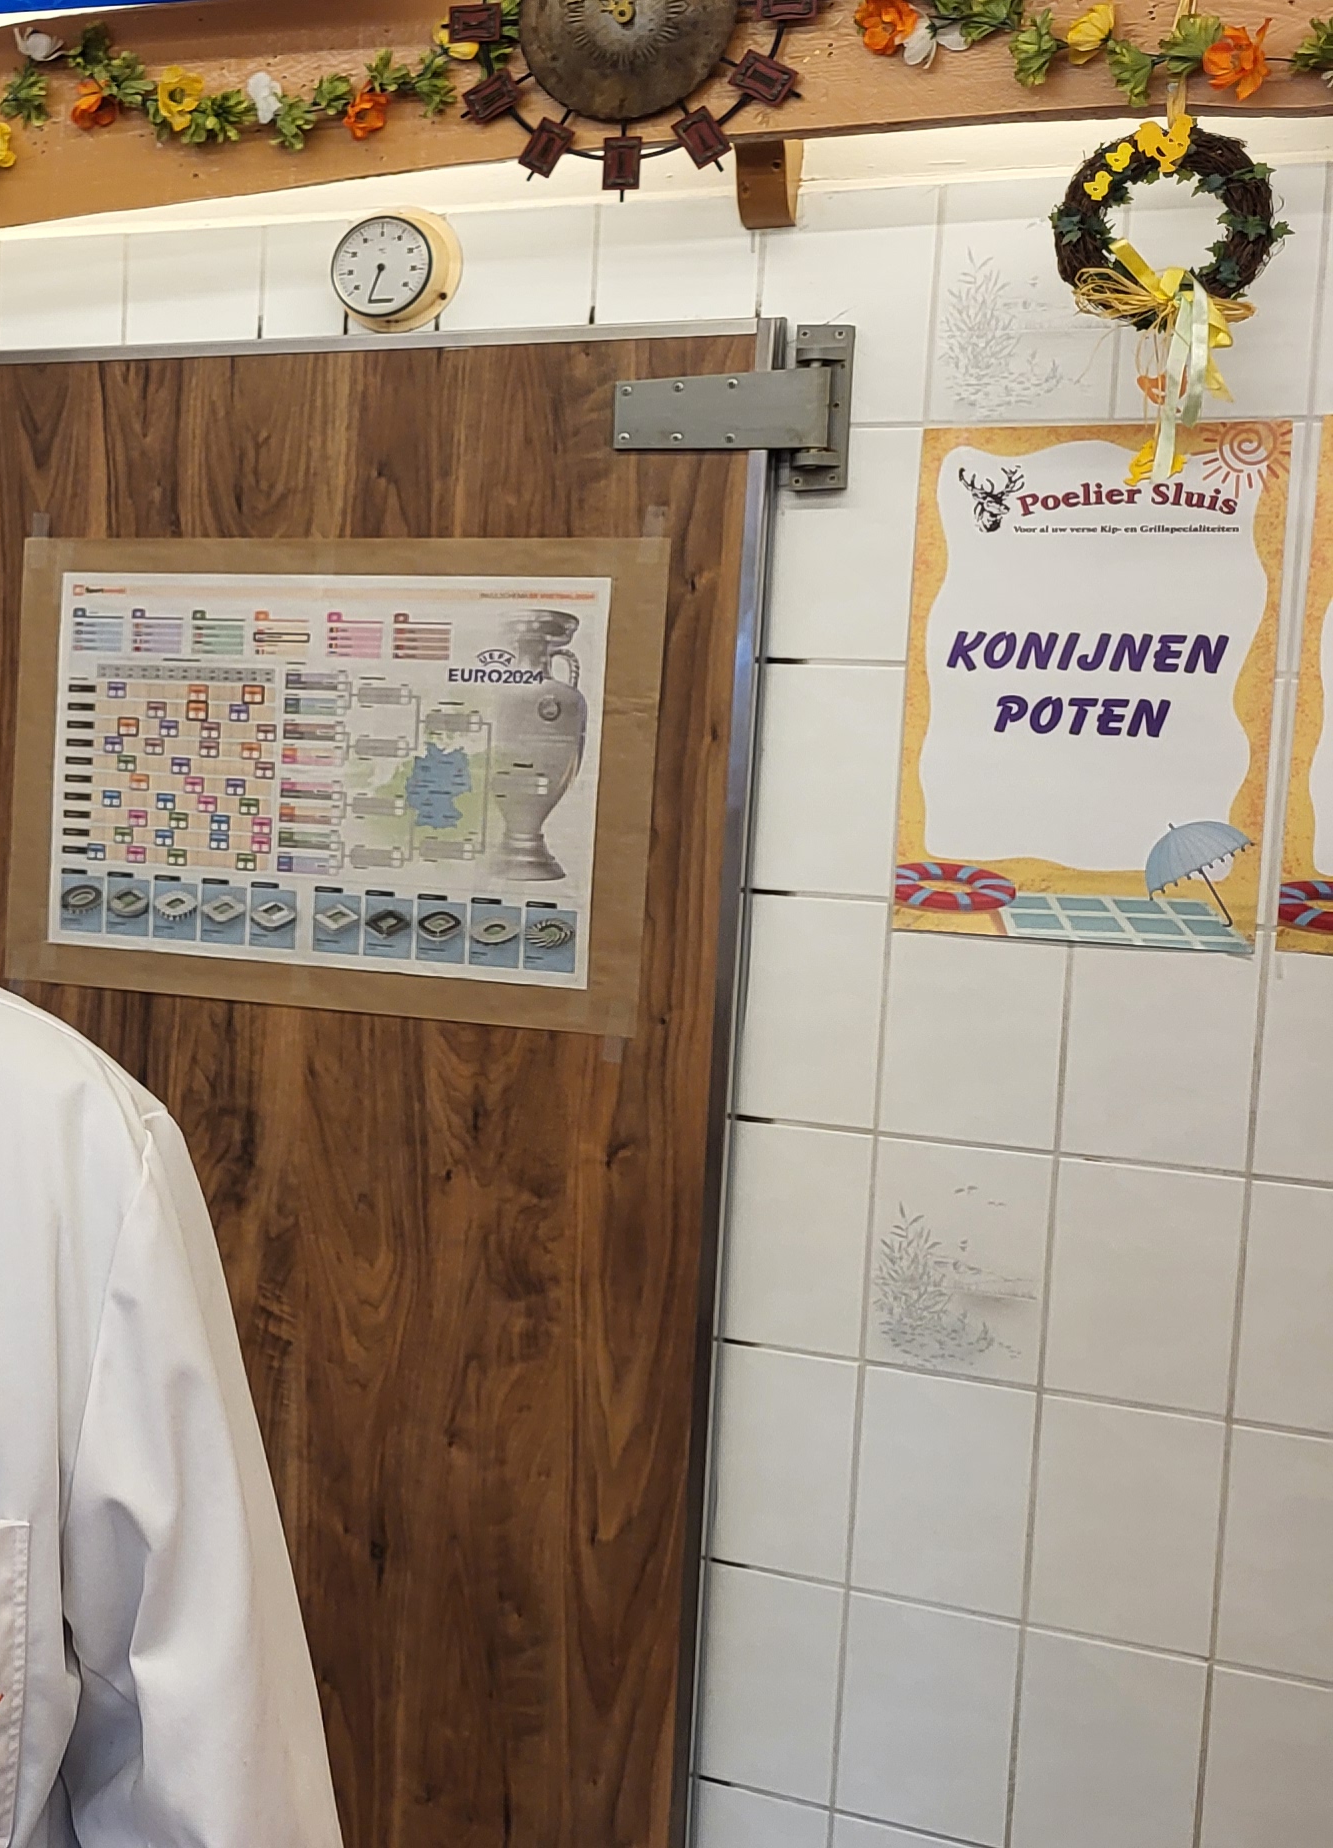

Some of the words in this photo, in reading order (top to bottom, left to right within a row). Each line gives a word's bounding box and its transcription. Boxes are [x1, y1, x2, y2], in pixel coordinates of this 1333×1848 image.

[1016, 482, 1142, 517] Poelier
[1150, 482, 1238, 516] Sluis
[1013, 524, 1038, 534] Voor
[1039, 524, 1050, 534] al
[1051, 525, 1068, 534] uw
[1069, 525, 1099, 534] verse
[1100, 524, 1122, 536] Kip-
[1124, 525, 1138, 534] en
[1139, 523, 1240, 535] Grillspecialiteiten
[478, 651, 513, 666] UEFA
[946, 630, 1230, 674] KONIJNEN
[448, 667, 545, 685] EURO2024
[993, 694, 1172, 738] POTEN
